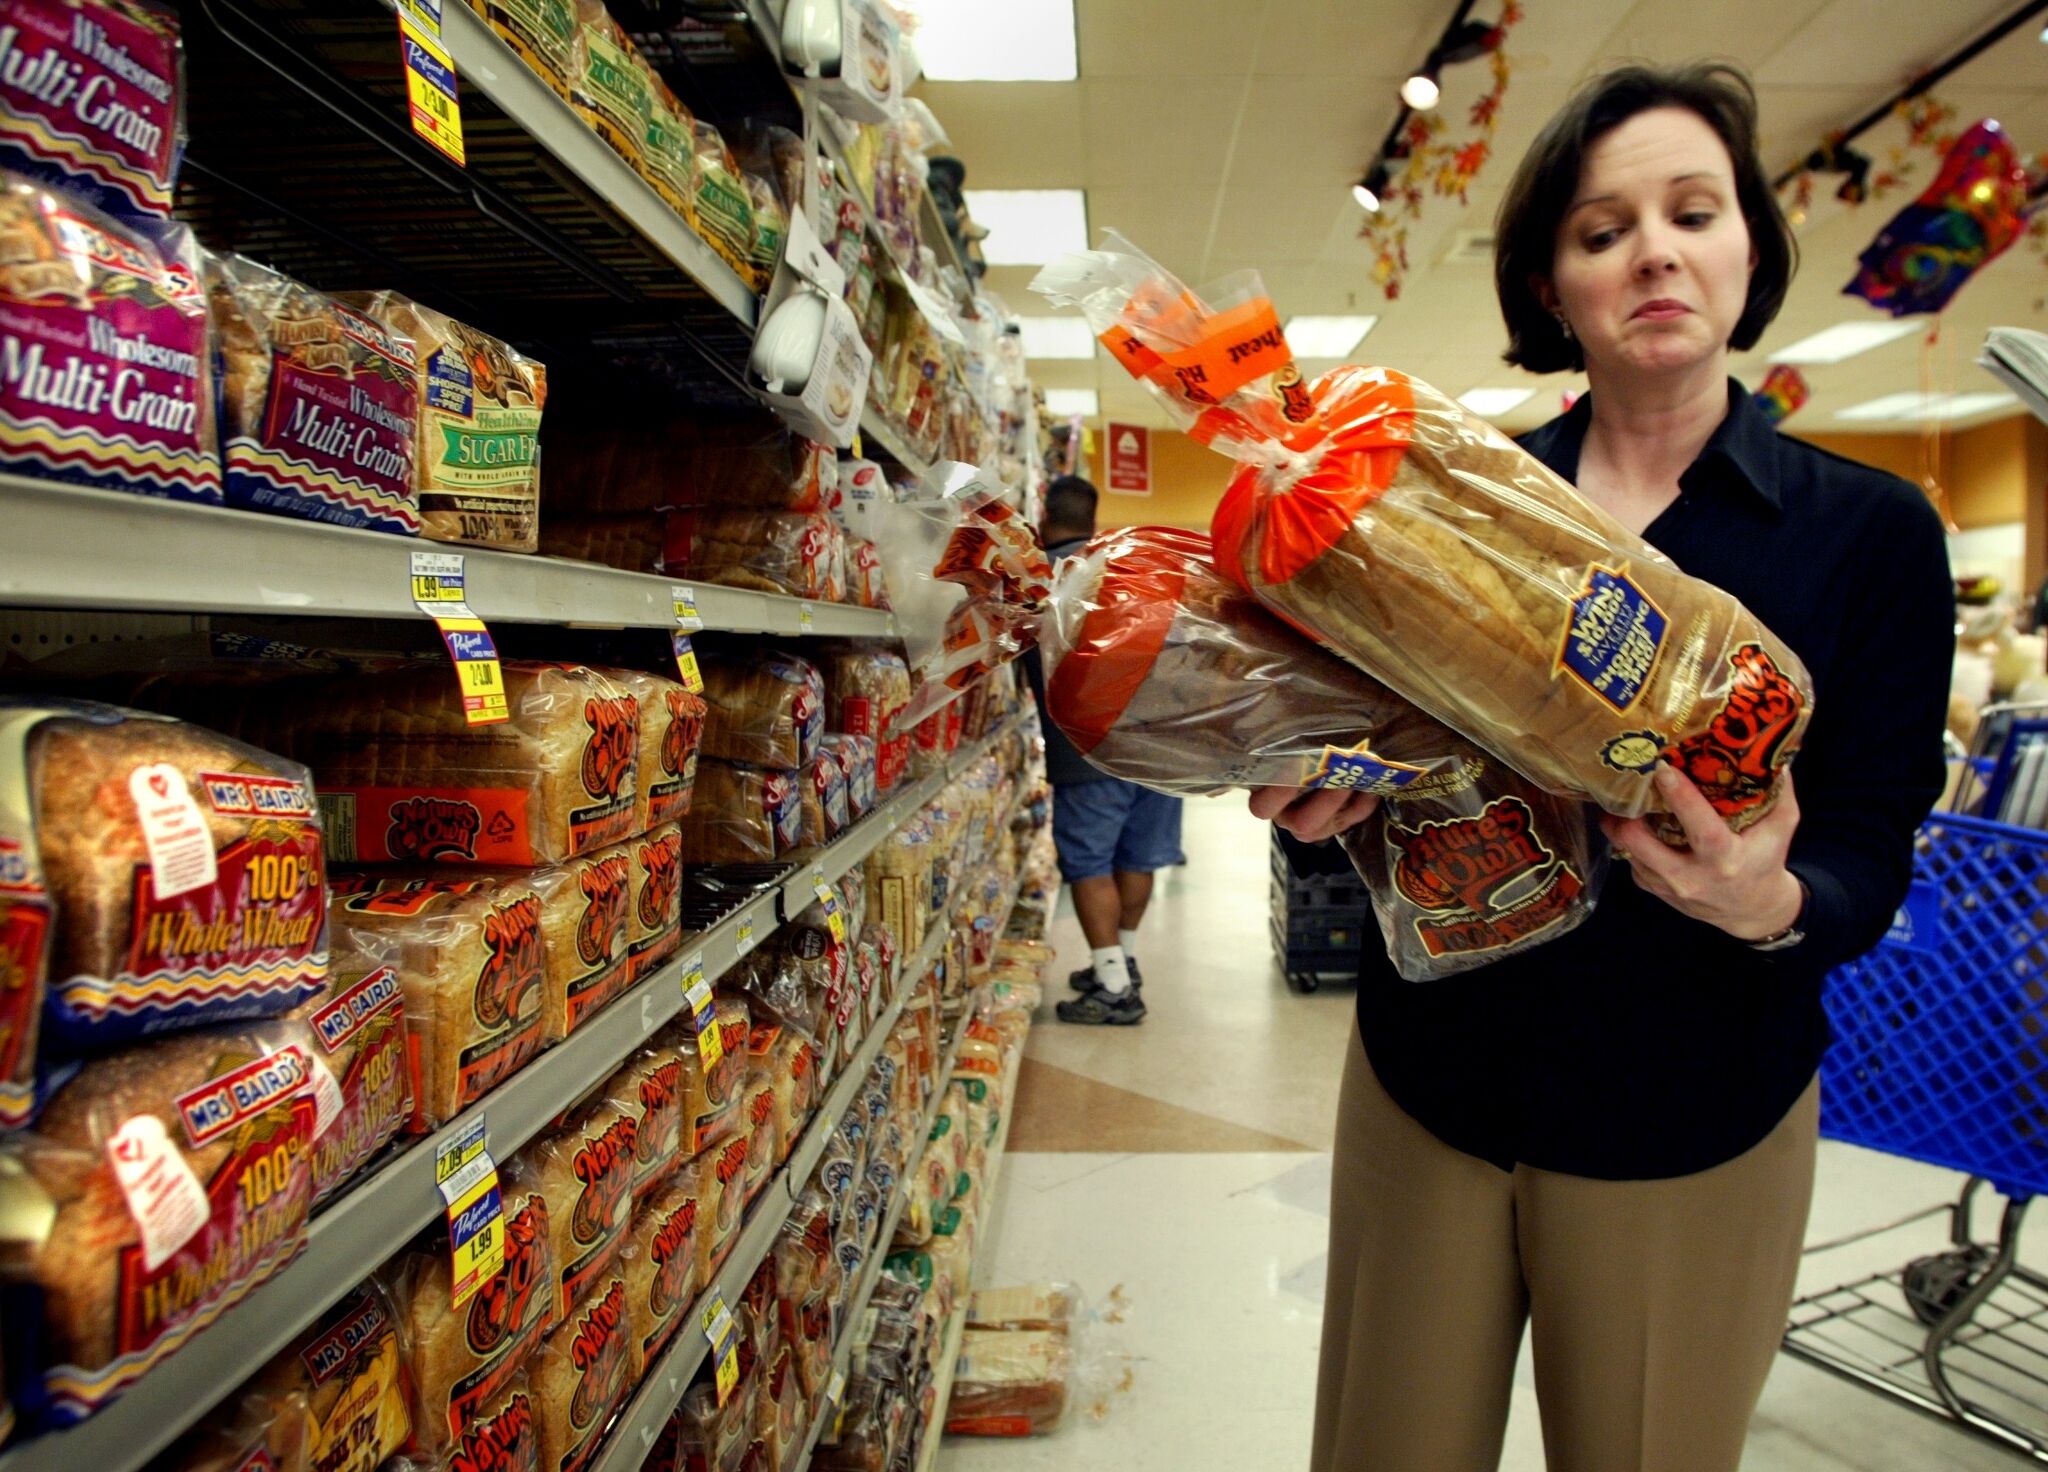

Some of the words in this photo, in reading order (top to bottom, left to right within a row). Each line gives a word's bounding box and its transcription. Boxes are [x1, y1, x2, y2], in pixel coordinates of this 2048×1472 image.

[72, 13, 173, 104] Wholesome
[0, 25, 162, 158] ulti-Grain
[2, 335, 197, 435] Multi-Grain
[281, 397, 404, 482] Multi-Grain
[459, 434, 517, 465] SUGAR
[455, 472, 472, 480] WITH
[477, 471, 499, 480] WHOLE
[415, 575, 437, 598] 1.99
[1571, 586, 1614, 640] WIN
[1577, 587, 1626, 658] $10,000
[448, 632, 482, 660] Preferred
[1593, 600, 1651, 691] SHOPPING
[209, 782, 249, 808] MRS
[398, 799, 476, 832] Nature's
[425, 815, 470, 843] Own
[246, 854, 319, 902] 100%
[1437, 833, 1536, 886] Own
[144, 908, 233, 956] Whole
[237, 906, 316, 952] Wheat
[320, 1006, 353, 1042] MRS
[351, 972, 397, 1020] BAIRD'S
[188, 1092, 233, 1132] MRS
[232, 1052, 303, 1109] BAIRD'S
[439, 1145, 463, 1180] 2.09
[453, 1194, 490, 1249] Preferred
[470, 1226, 492, 1262] 1.99
[473, 1218, 487, 1232] CARD
[312, 1338, 346, 1377] MRS
[335, 1381, 379, 1436] BUTTERED
